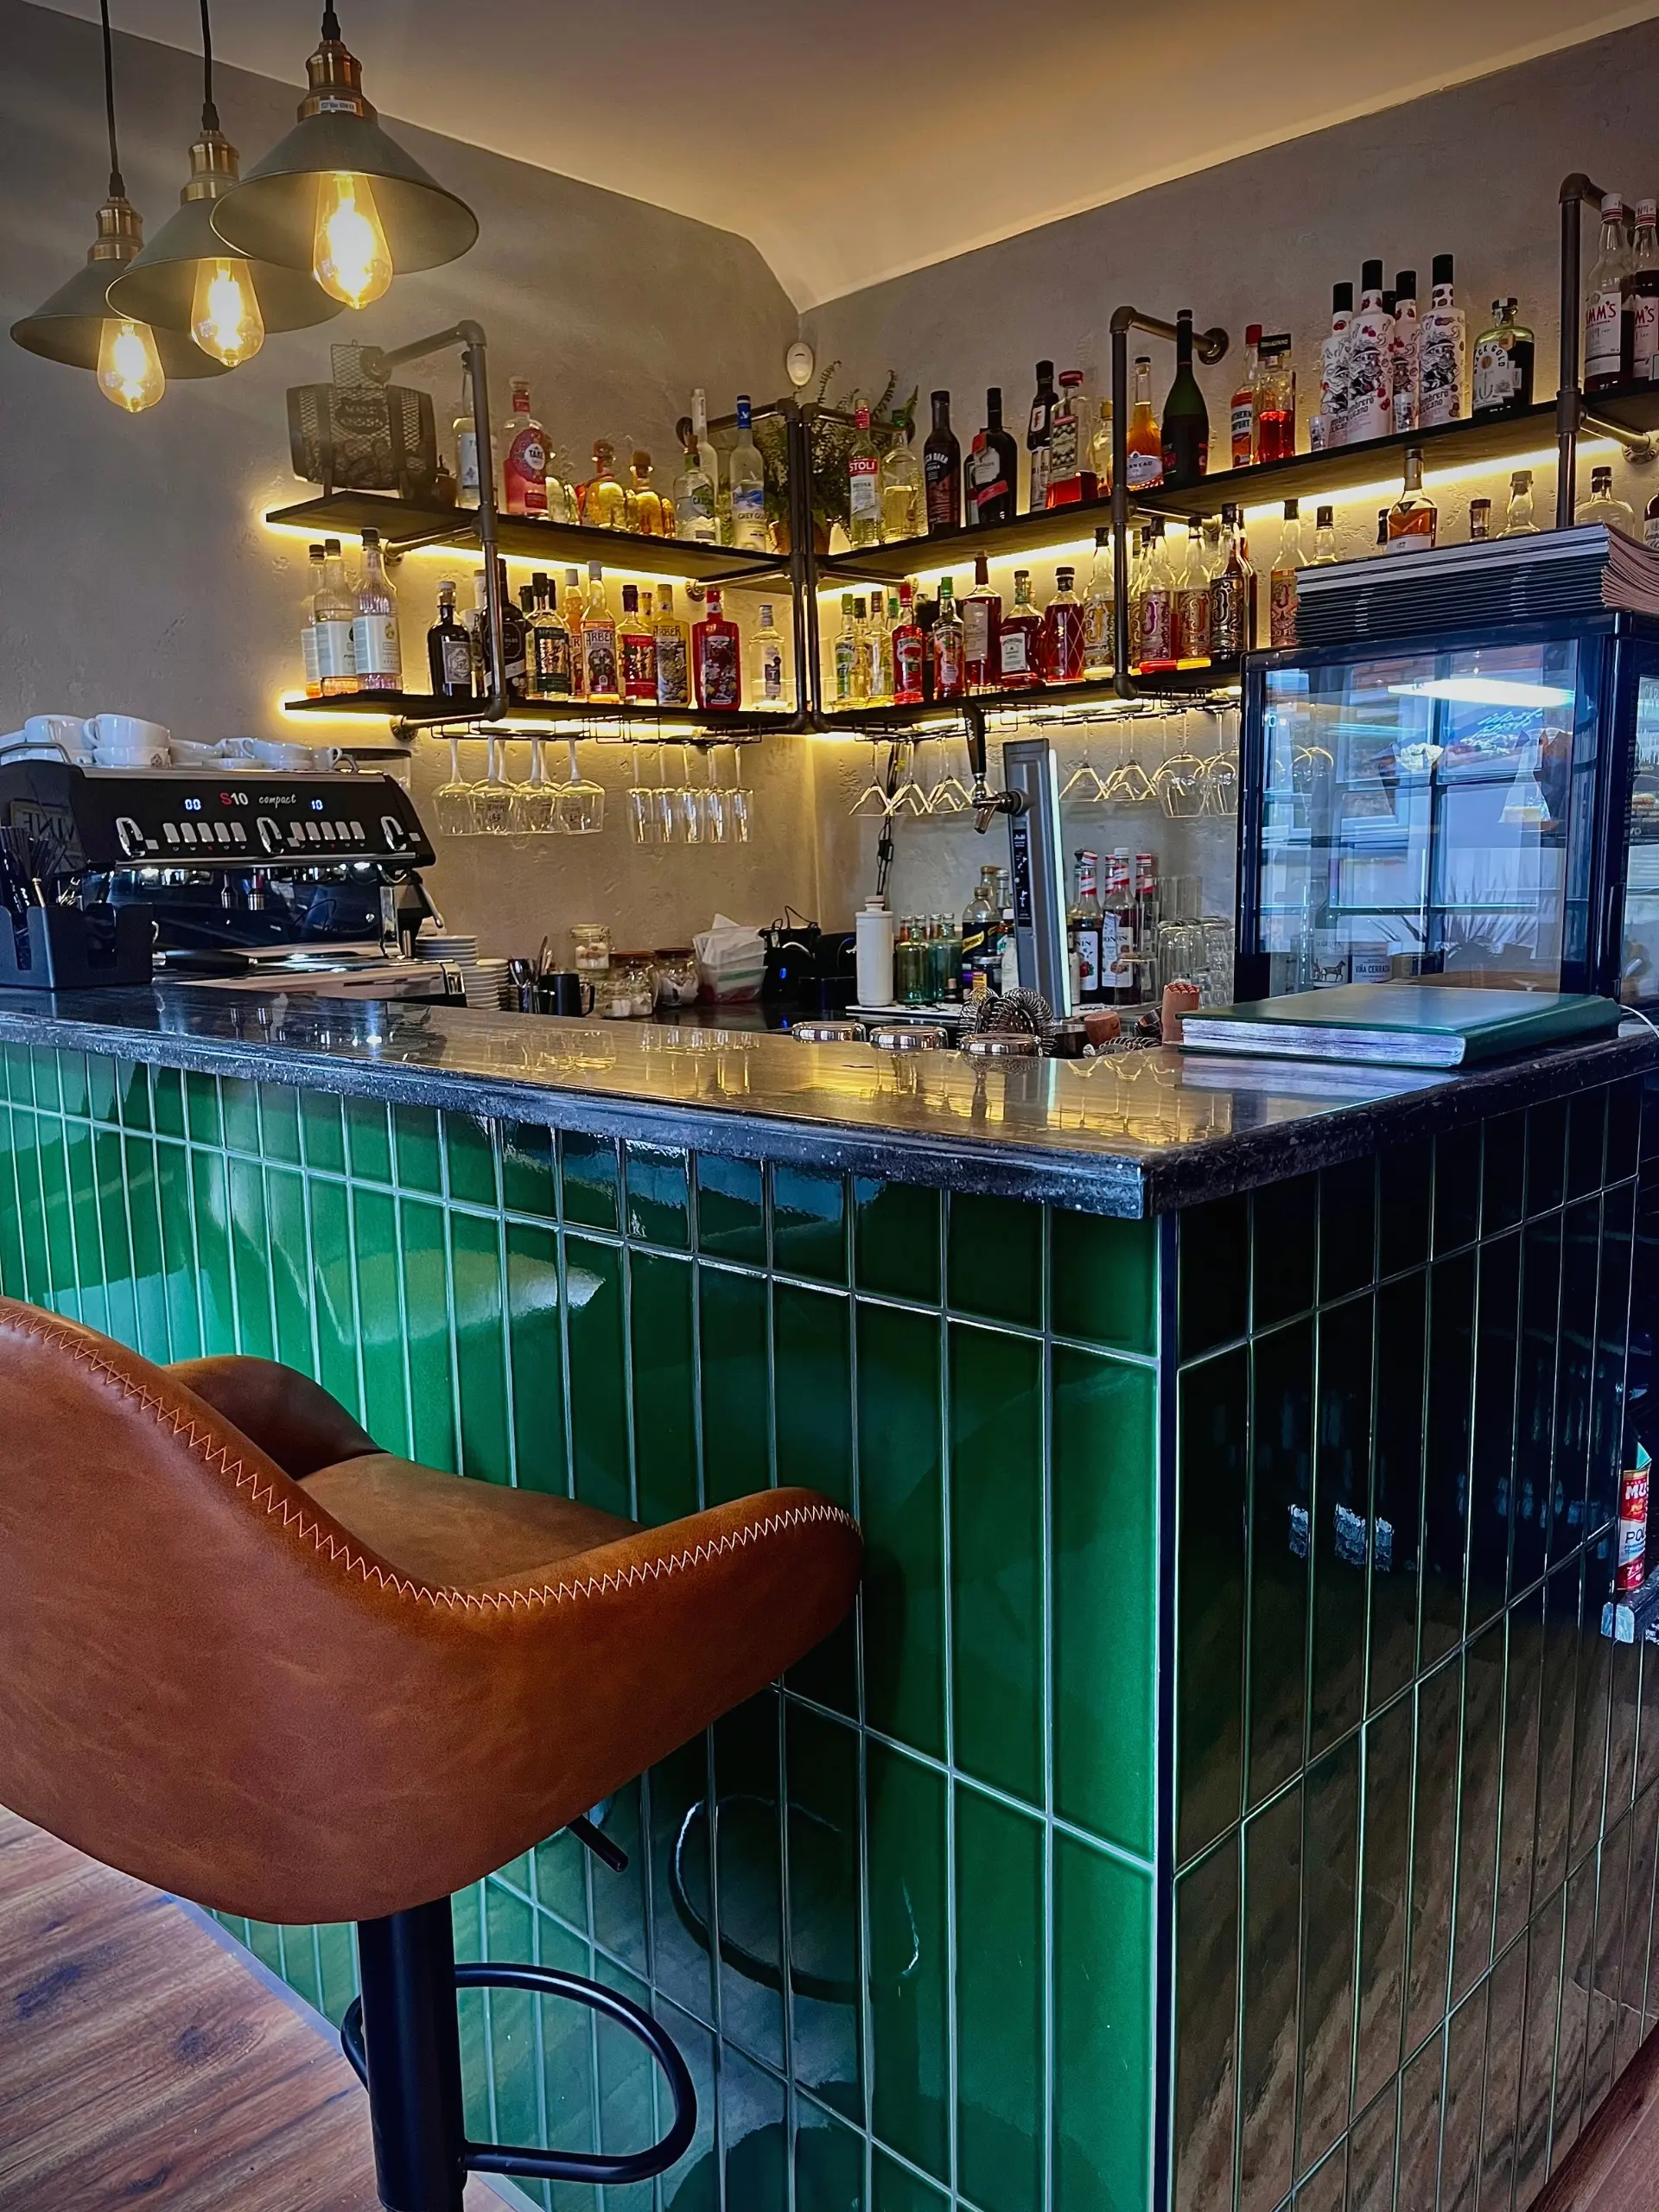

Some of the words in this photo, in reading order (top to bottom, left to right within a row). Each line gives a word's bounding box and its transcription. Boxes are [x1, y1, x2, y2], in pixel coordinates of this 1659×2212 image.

[1586, 301, 1616, 324] IMM'S
[1491, 345, 1505, 367] GOLD
[849, 461, 874, 473] STOLI
[652, 625, 682, 639] ARBER
[184, 798, 201, 810] 00
[219, 792, 249, 805] S10
[259, 793, 296, 809] compact
[311, 799, 323, 810] 10
[1355, 963, 1367, 974] VIÑA
